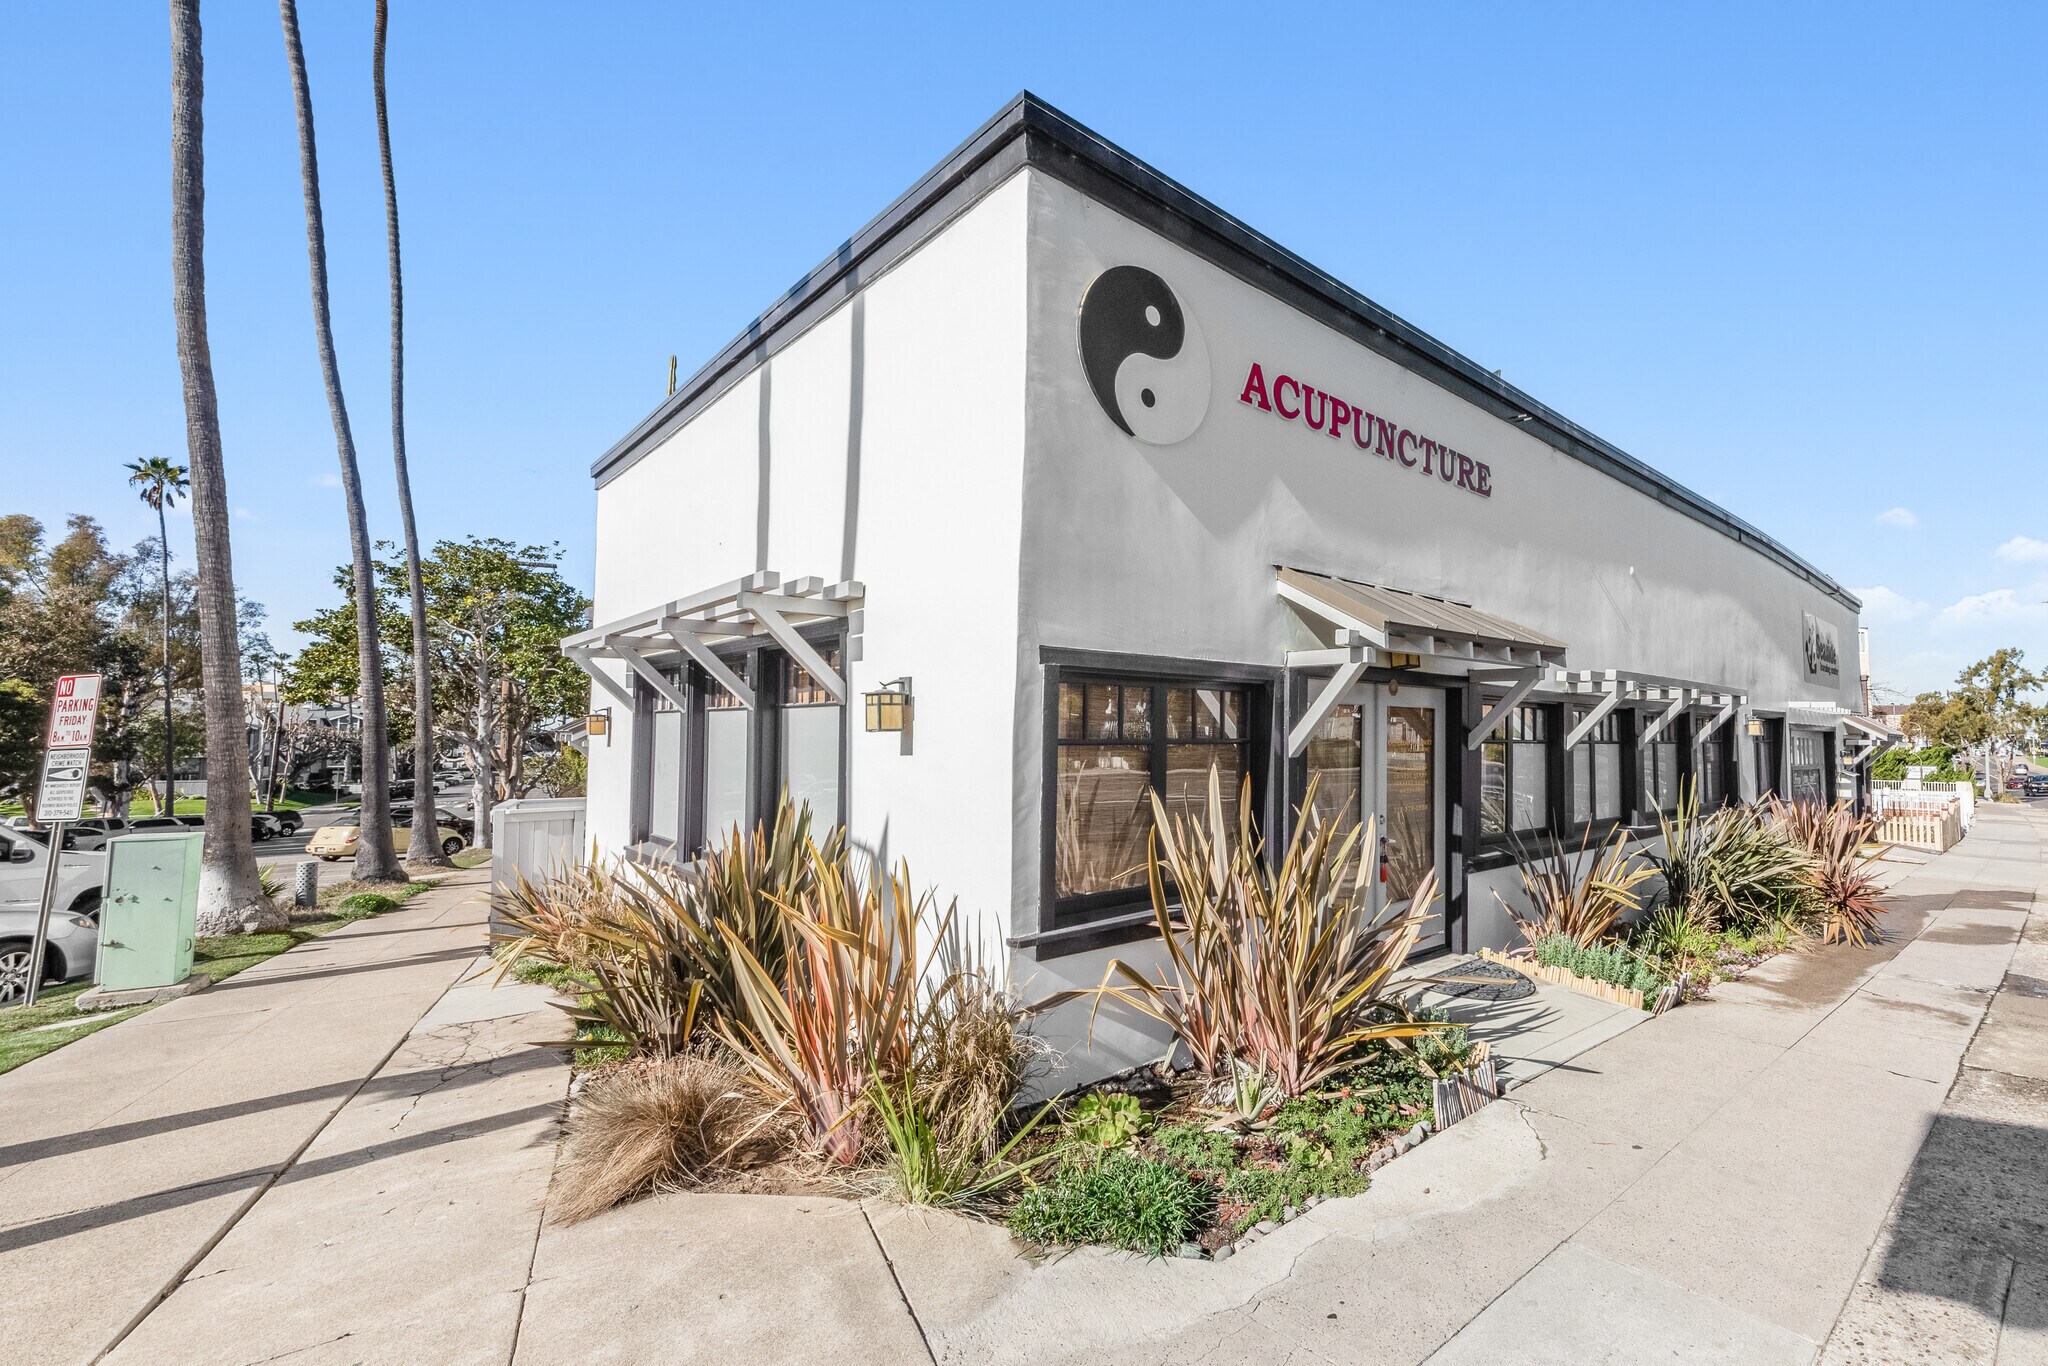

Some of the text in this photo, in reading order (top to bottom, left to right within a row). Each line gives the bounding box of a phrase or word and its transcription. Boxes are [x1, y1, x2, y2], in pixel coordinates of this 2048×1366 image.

[1238, 362, 1492, 498] ACUPUNCTURE
[60, 680, 73, 695] NO
[57, 698, 94, 712] PARKING
[59, 715, 87, 726] FRIDAY
[51, 752, 86, 760] NEIGHBORHOOD
